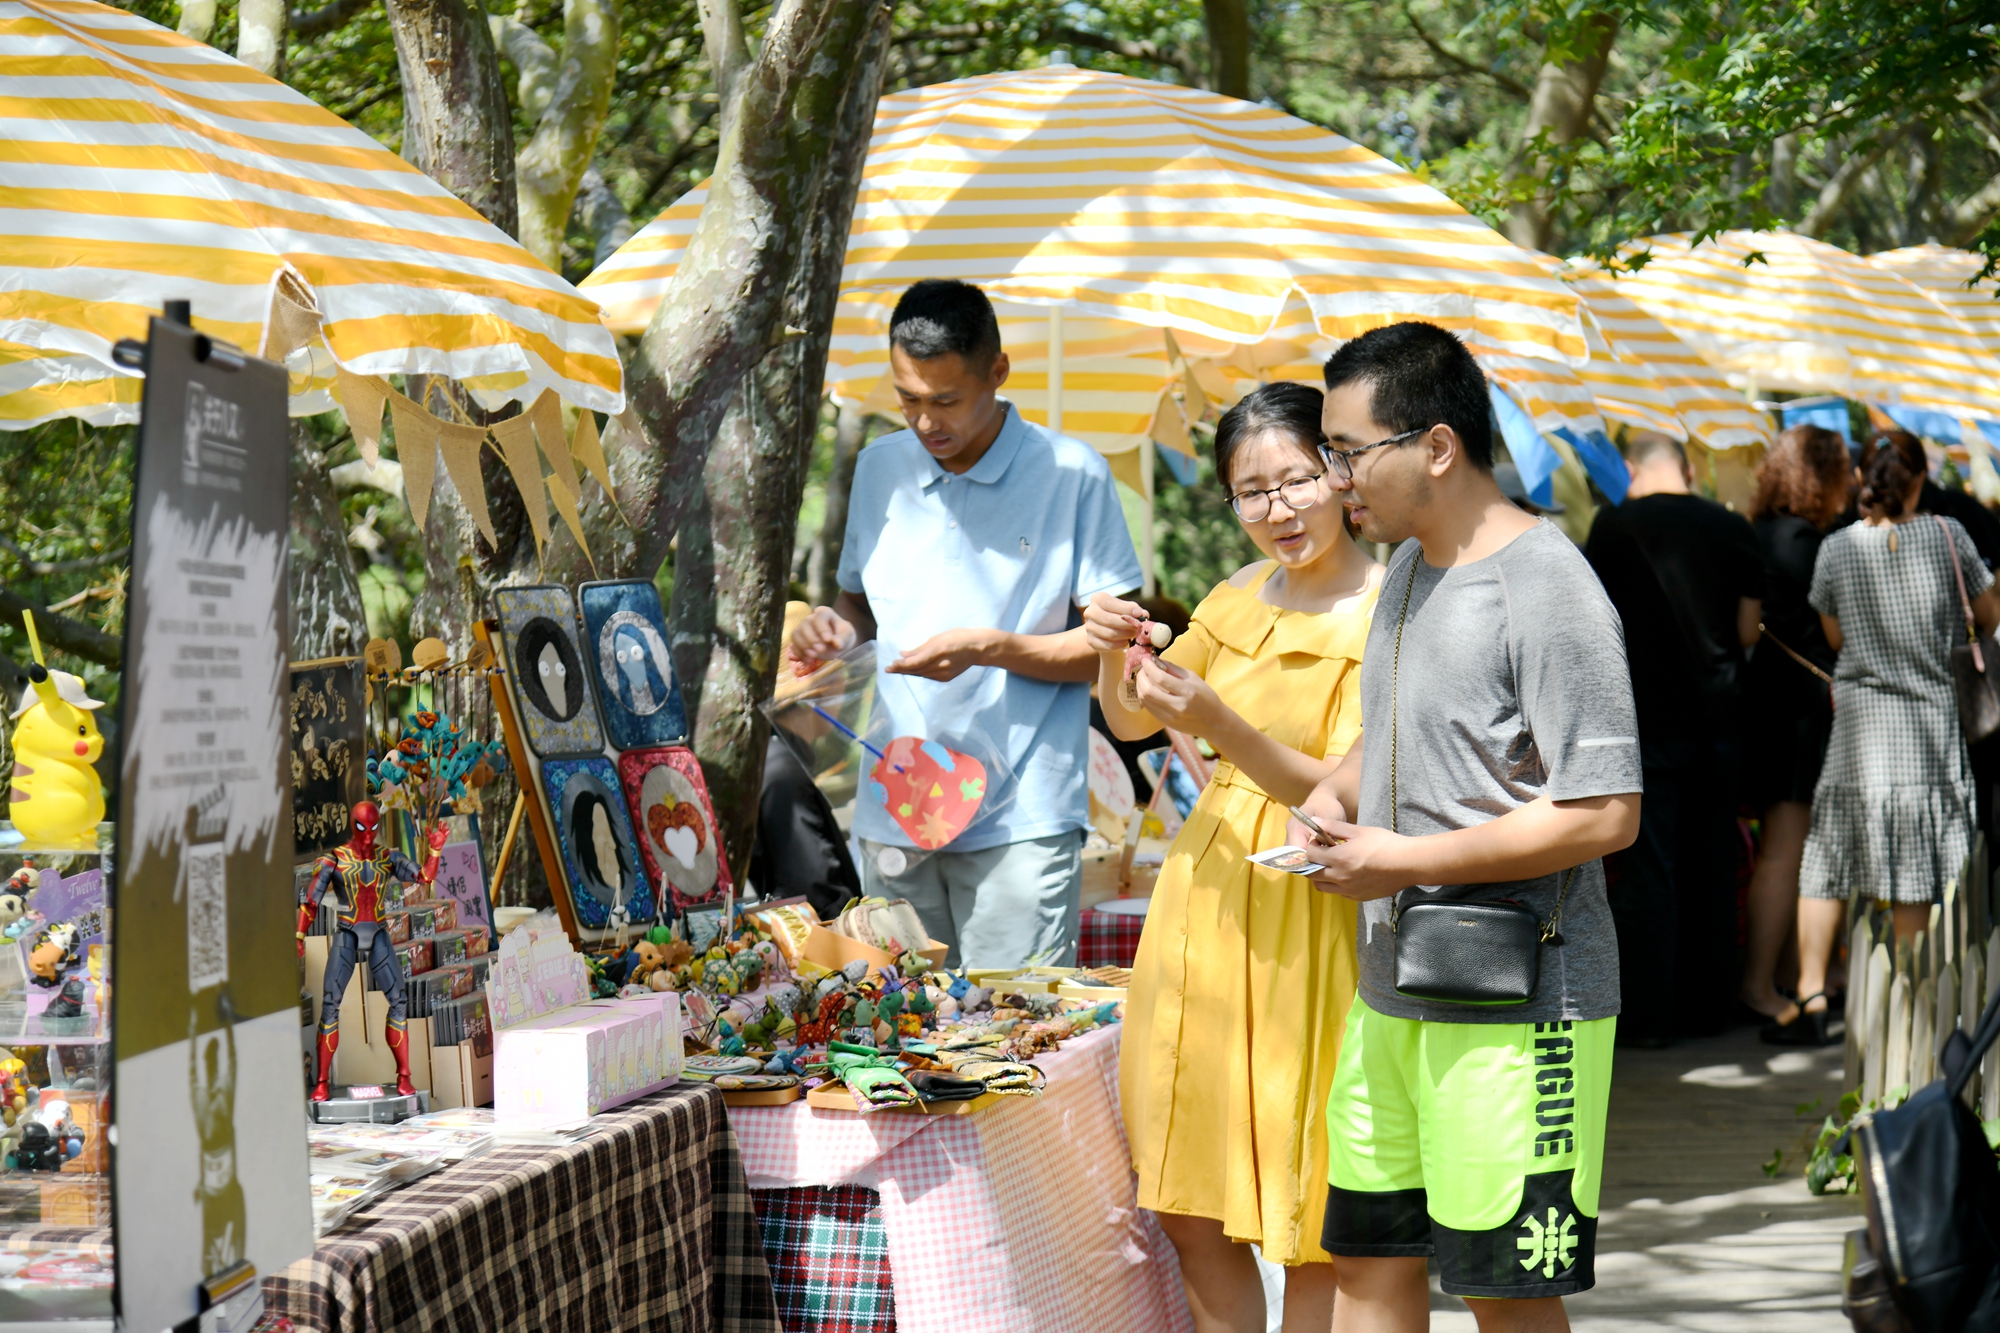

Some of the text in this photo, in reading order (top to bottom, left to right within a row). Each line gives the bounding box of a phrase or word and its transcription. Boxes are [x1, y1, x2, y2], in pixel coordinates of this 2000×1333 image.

[68, 873, 98, 899] Twelve
[533, 937, 572, 963] ANIMAL
[537, 956, 569, 983] SERIES
[351, 1086, 384, 1099] MARVEL
